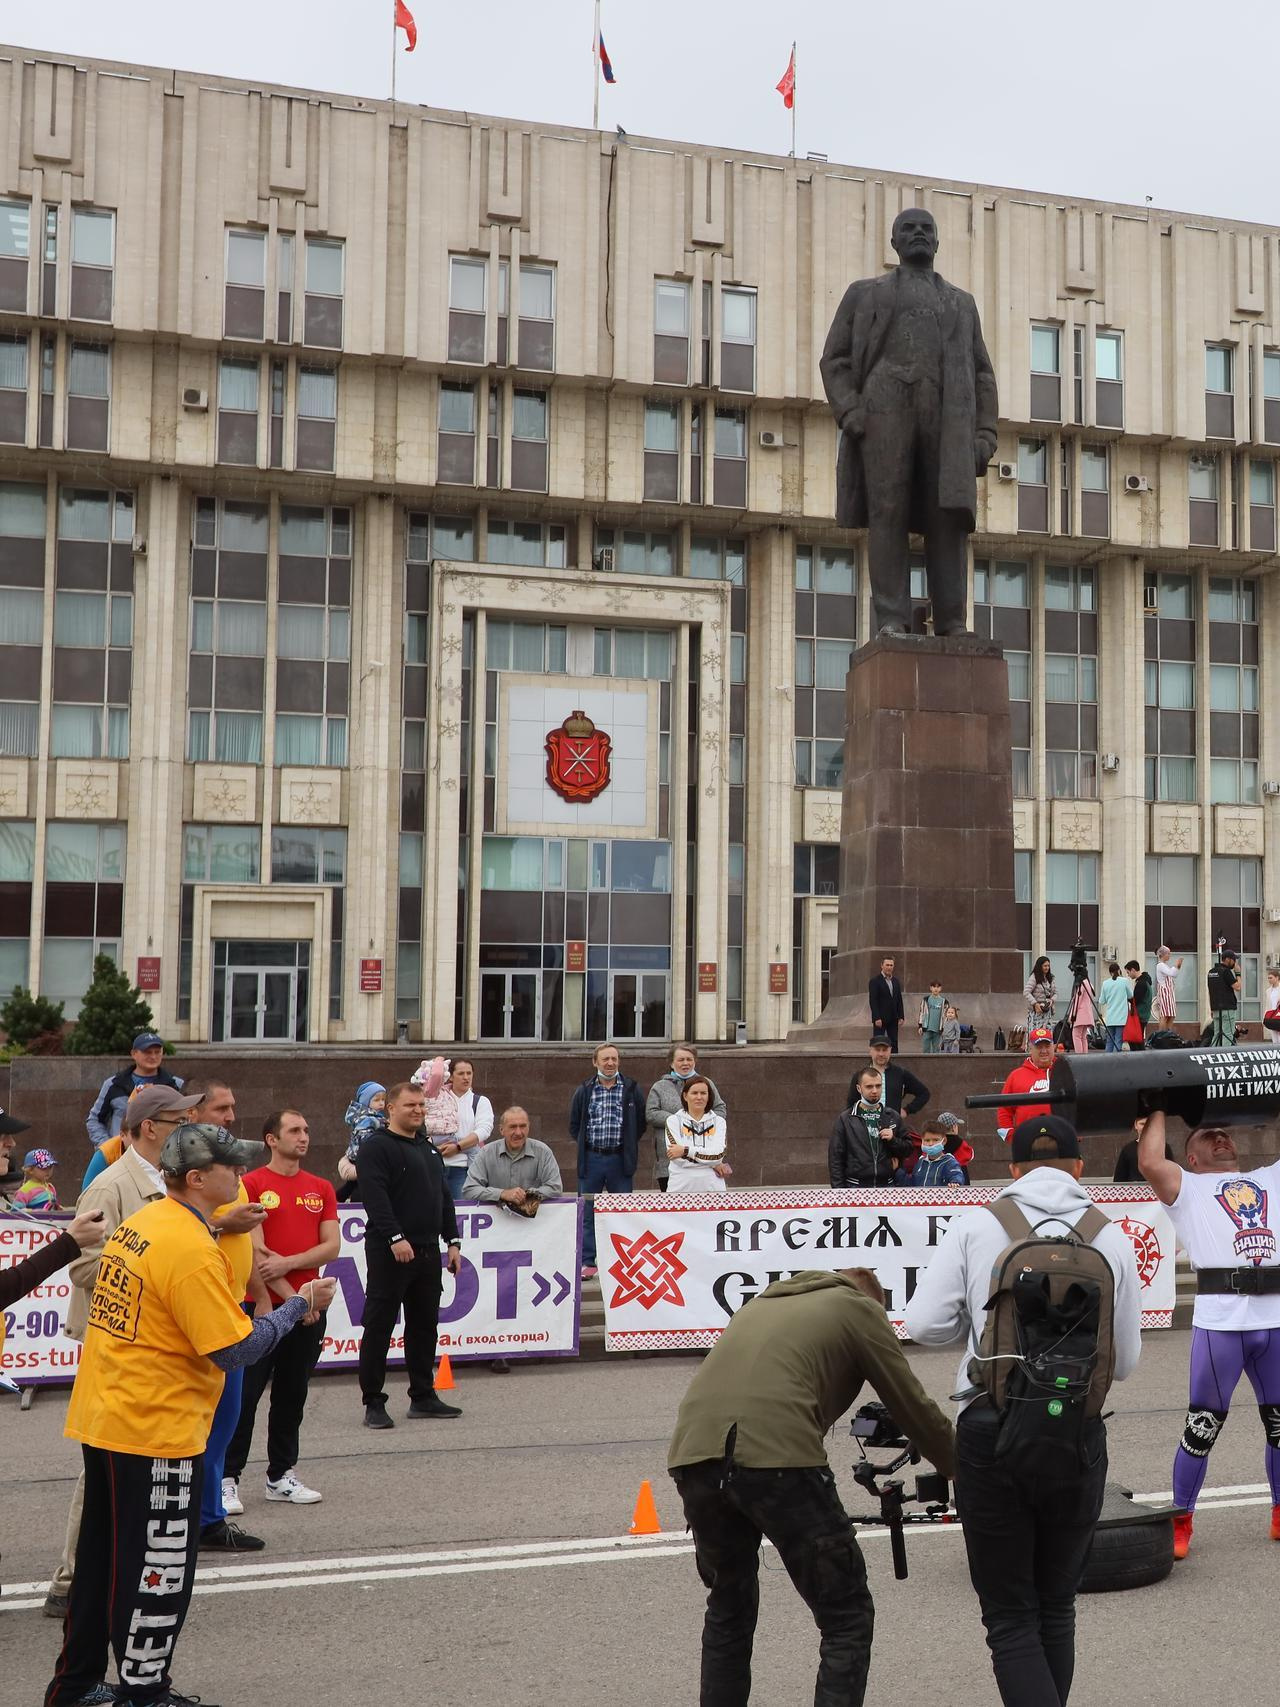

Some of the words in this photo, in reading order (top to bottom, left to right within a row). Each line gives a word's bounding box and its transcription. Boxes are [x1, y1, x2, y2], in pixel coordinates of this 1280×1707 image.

[111, 1226, 151, 1258] СУДЬЯ
[1234, 1235, 1276, 1254] НАЦИЯ
[1245, 1247, 1271, 1258] МИРА
[138, 1518, 189, 1596] BIG
[121, 1607, 179, 1686] GET
